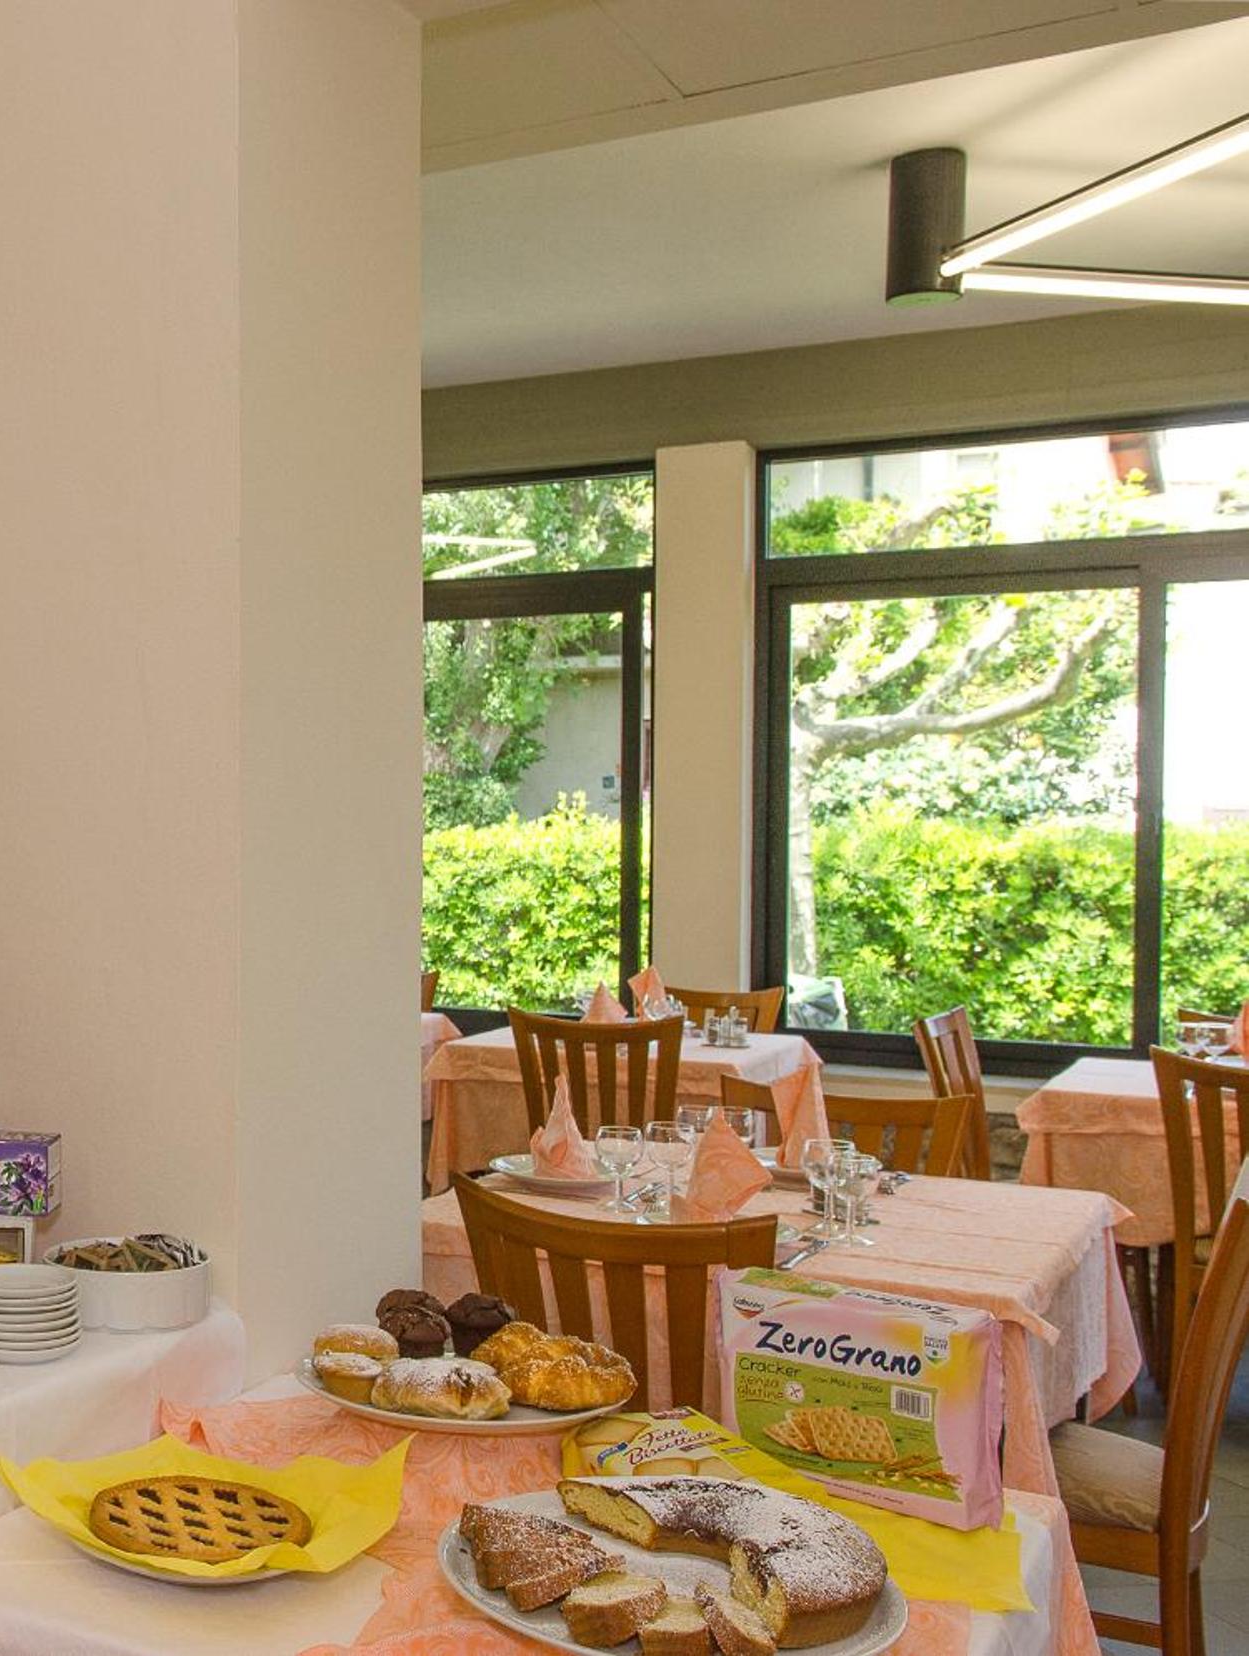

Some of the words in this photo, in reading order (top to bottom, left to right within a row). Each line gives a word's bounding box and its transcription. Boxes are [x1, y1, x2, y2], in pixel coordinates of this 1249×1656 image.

[755, 1320, 923, 1377] ZeroGrano
[738, 1357, 802, 1377] Cracker
[739, 1375, 779, 1389] senza
[737, 1384, 784, 1400] glutine
